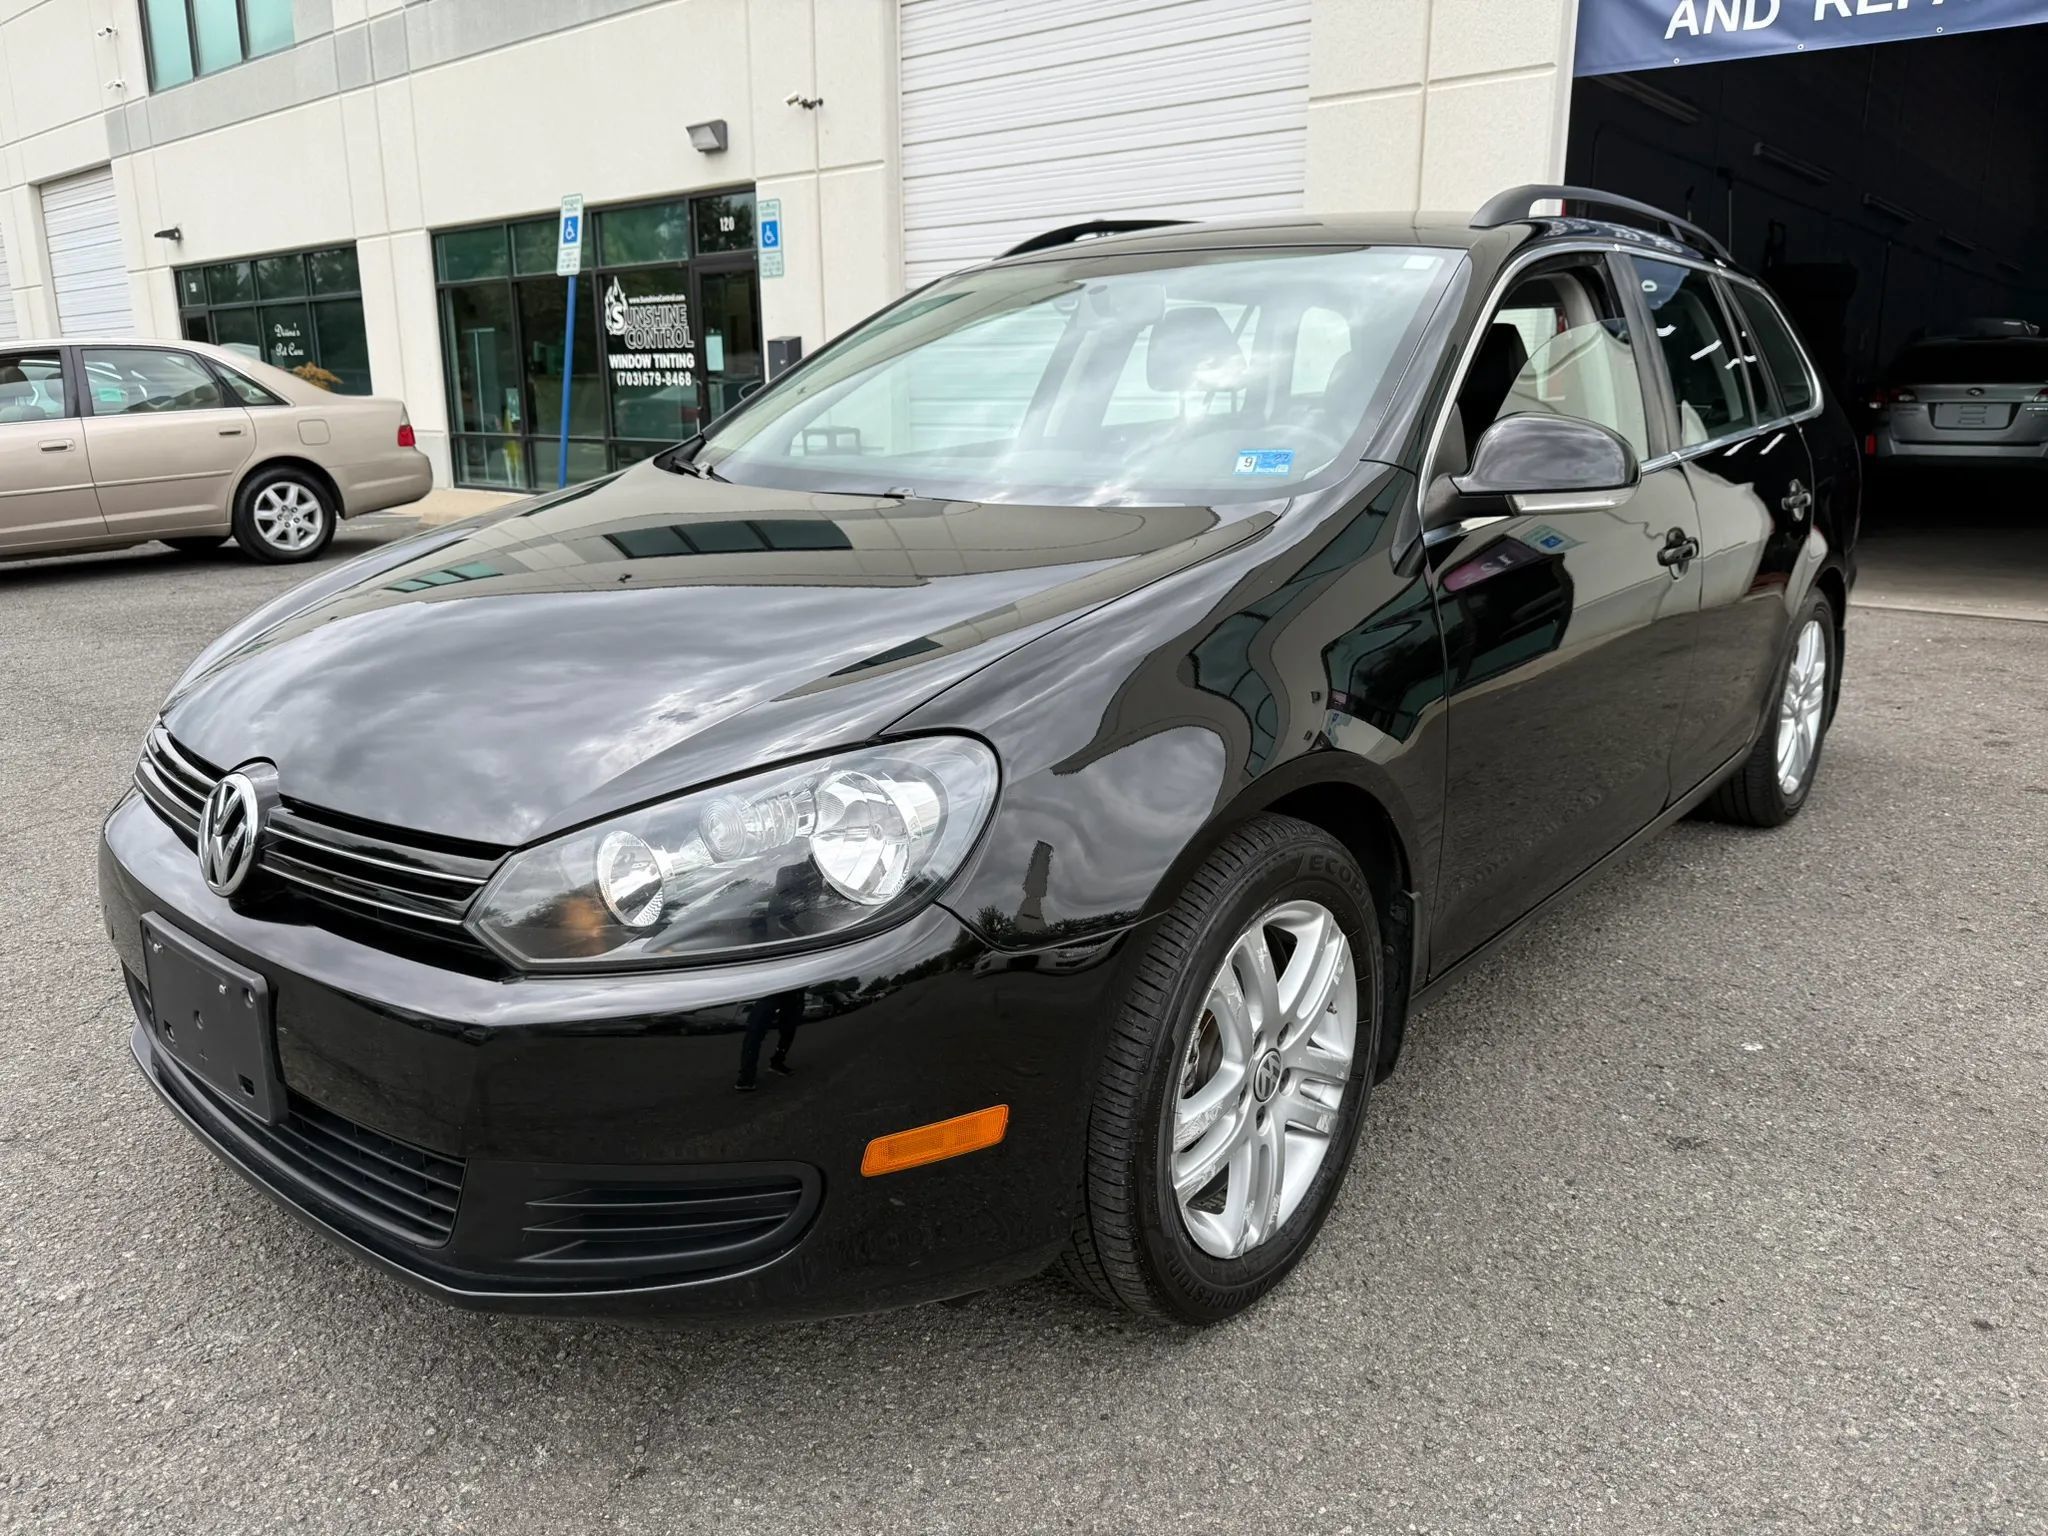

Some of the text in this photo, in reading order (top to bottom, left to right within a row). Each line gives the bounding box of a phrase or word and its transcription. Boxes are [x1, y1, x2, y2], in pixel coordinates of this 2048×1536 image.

[1664, 0, 1780, 39] AND
[719, 215, 735, 232] 120
[611, 303, 688, 330] SUNSHINE
[625, 327, 695, 349] CONTROL
[609, 353, 695, 369] WINDOW TINTING
[616, 371, 692, 386] (703)679-8468
[1244, 457, 1254, 468] 9
[198, 772, 258, 897] VW
[1254, 1048, 1281, 1102] VW
